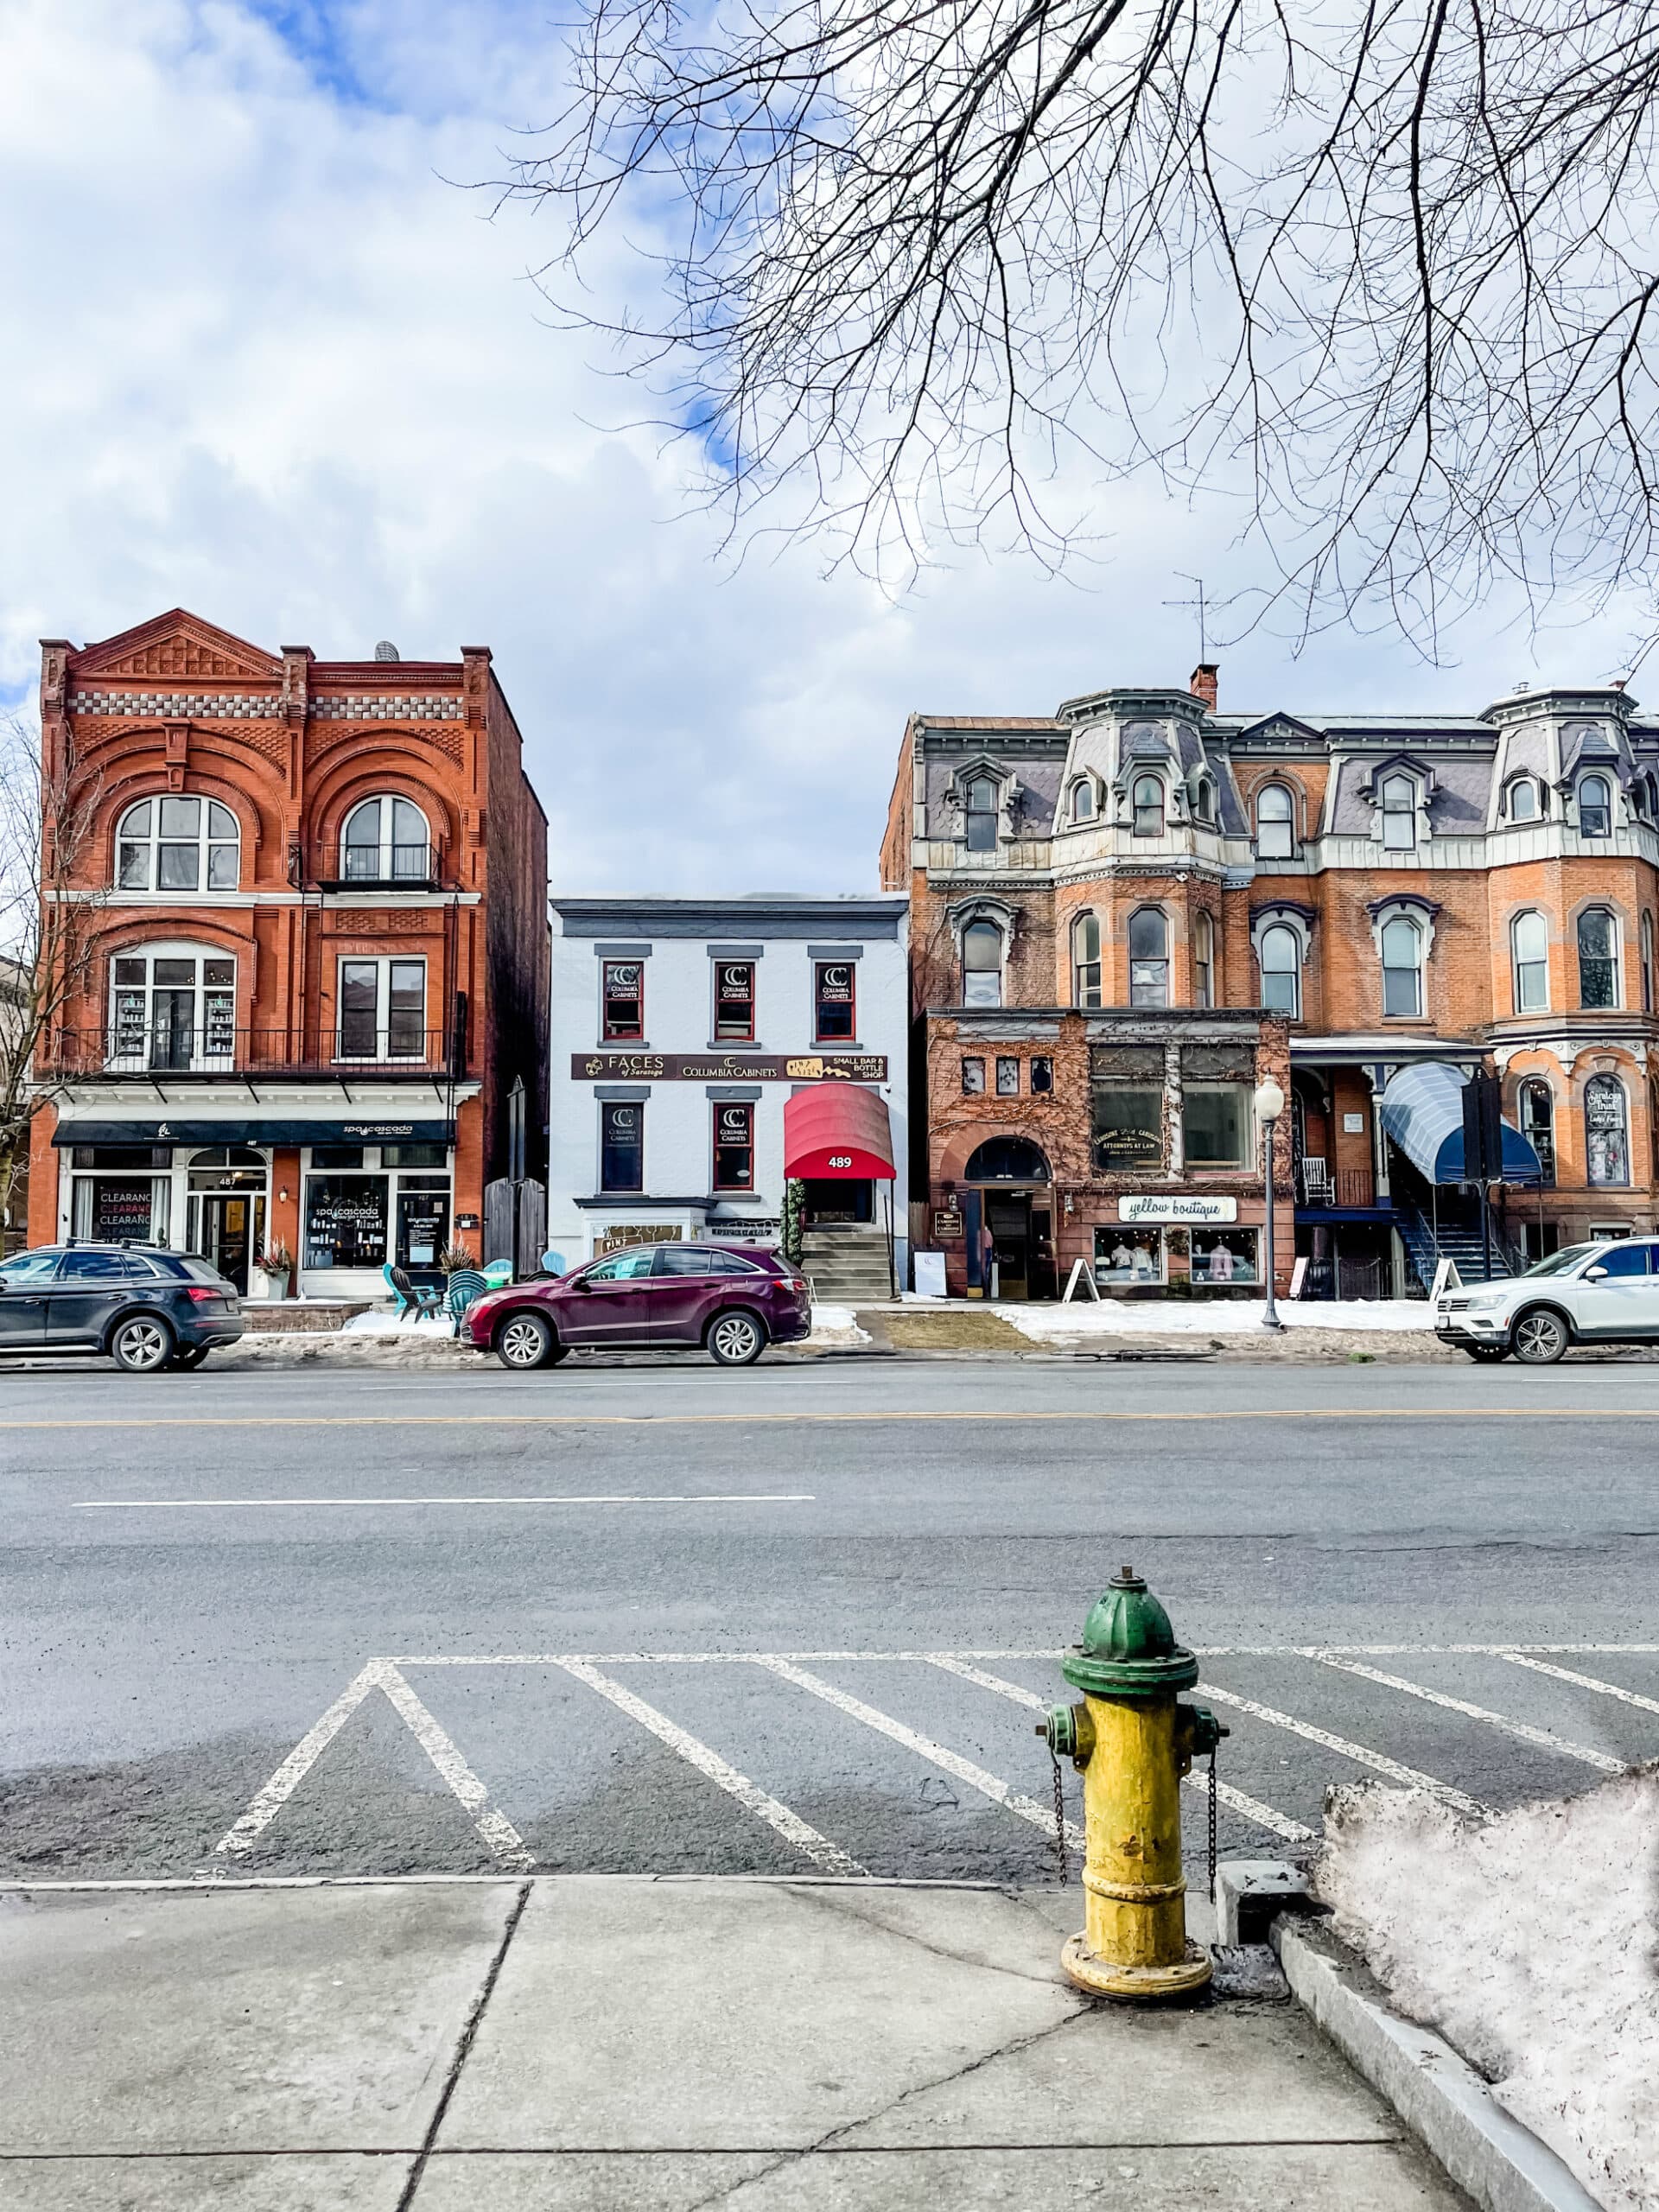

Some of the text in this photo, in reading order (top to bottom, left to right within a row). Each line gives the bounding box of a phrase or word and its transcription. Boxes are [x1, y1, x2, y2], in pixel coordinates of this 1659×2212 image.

[608, 1056, 664, 1069] FACES
[621, 1068, 664, 1077] of Saratoga
[683, 1066, 777, 1077] COLUMBIA CABINETS
[829, 1157, 852, 1167] 489
[100, 1193, 152, 1202] CLEARANC
[100, 1205, 151, 1213] CLEARANC
[337, 1207, 378, 1216] cascada
[1128, 1198, 1221, 1220] yellow boutique
[99, 1216, 150, 1224] CLEARANC
[99, 1227, 150, 1236] CLEARANC
